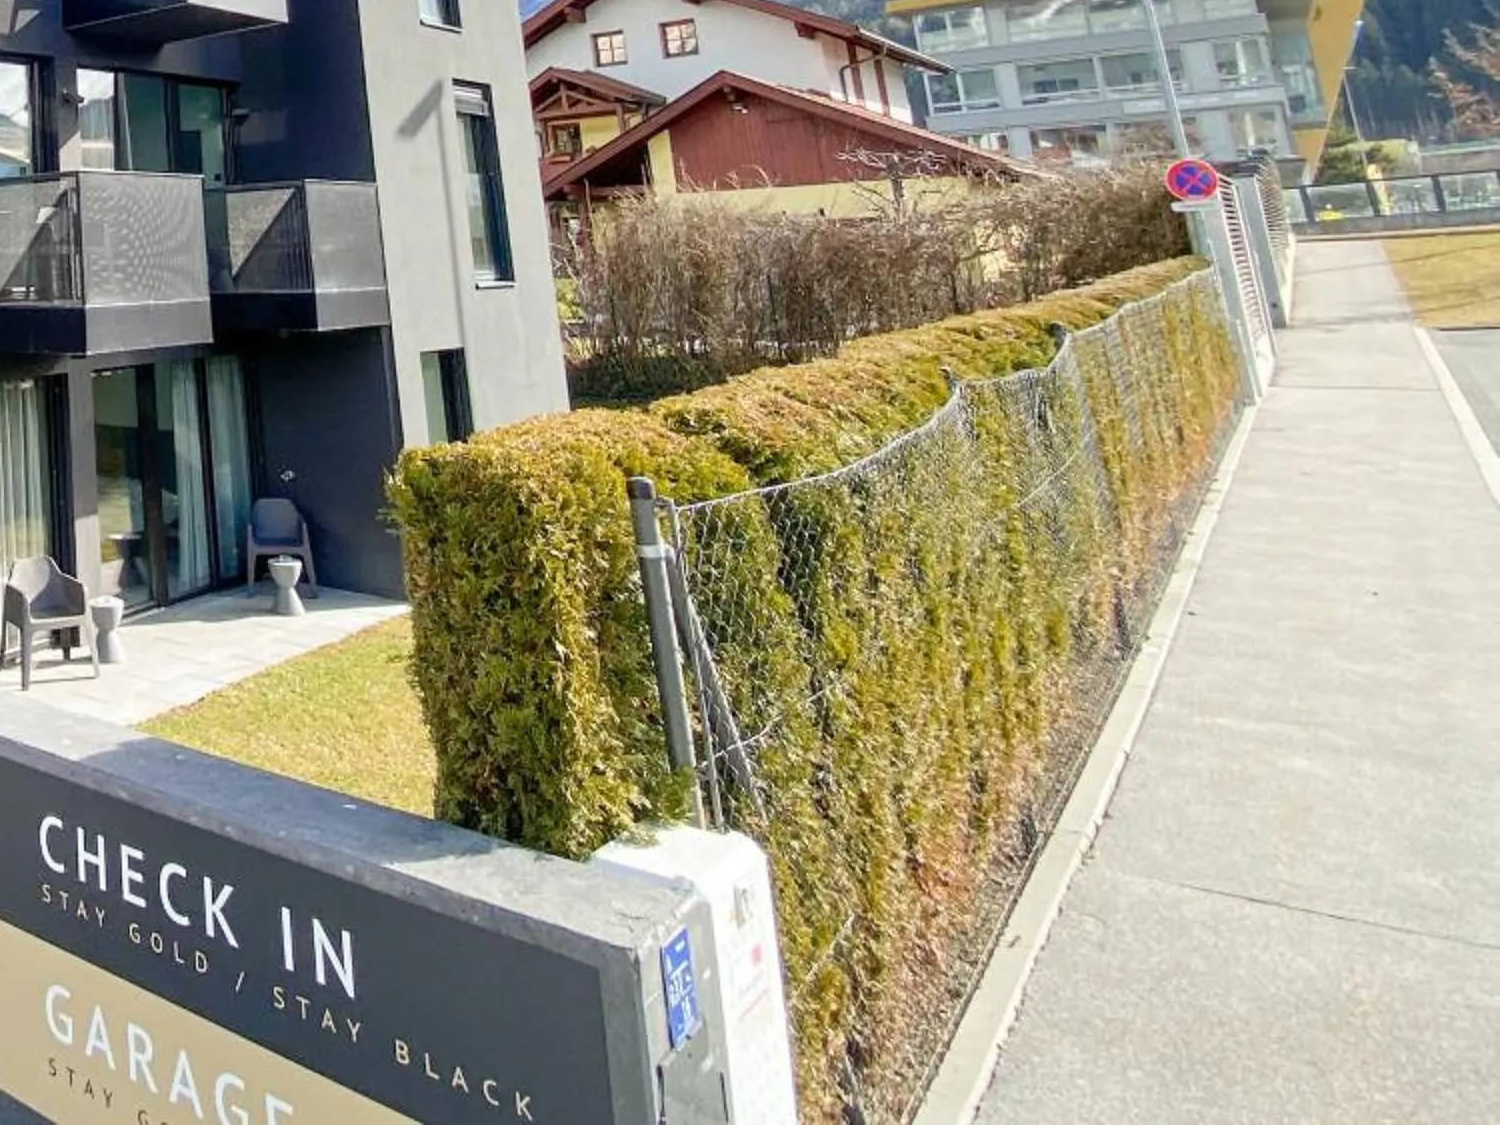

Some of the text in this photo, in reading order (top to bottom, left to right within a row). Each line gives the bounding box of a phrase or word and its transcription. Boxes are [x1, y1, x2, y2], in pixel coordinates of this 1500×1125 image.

[39, 816, 355, 998] CHECK IN
[41, 884, 105, 927] STAY
[129, 923, 207, 973] GOLD
[272, 986, 360, 1042] STAY
[395, 1039, 533, 1121] BLACK
[48, 1058, 113, 1108] STAY
